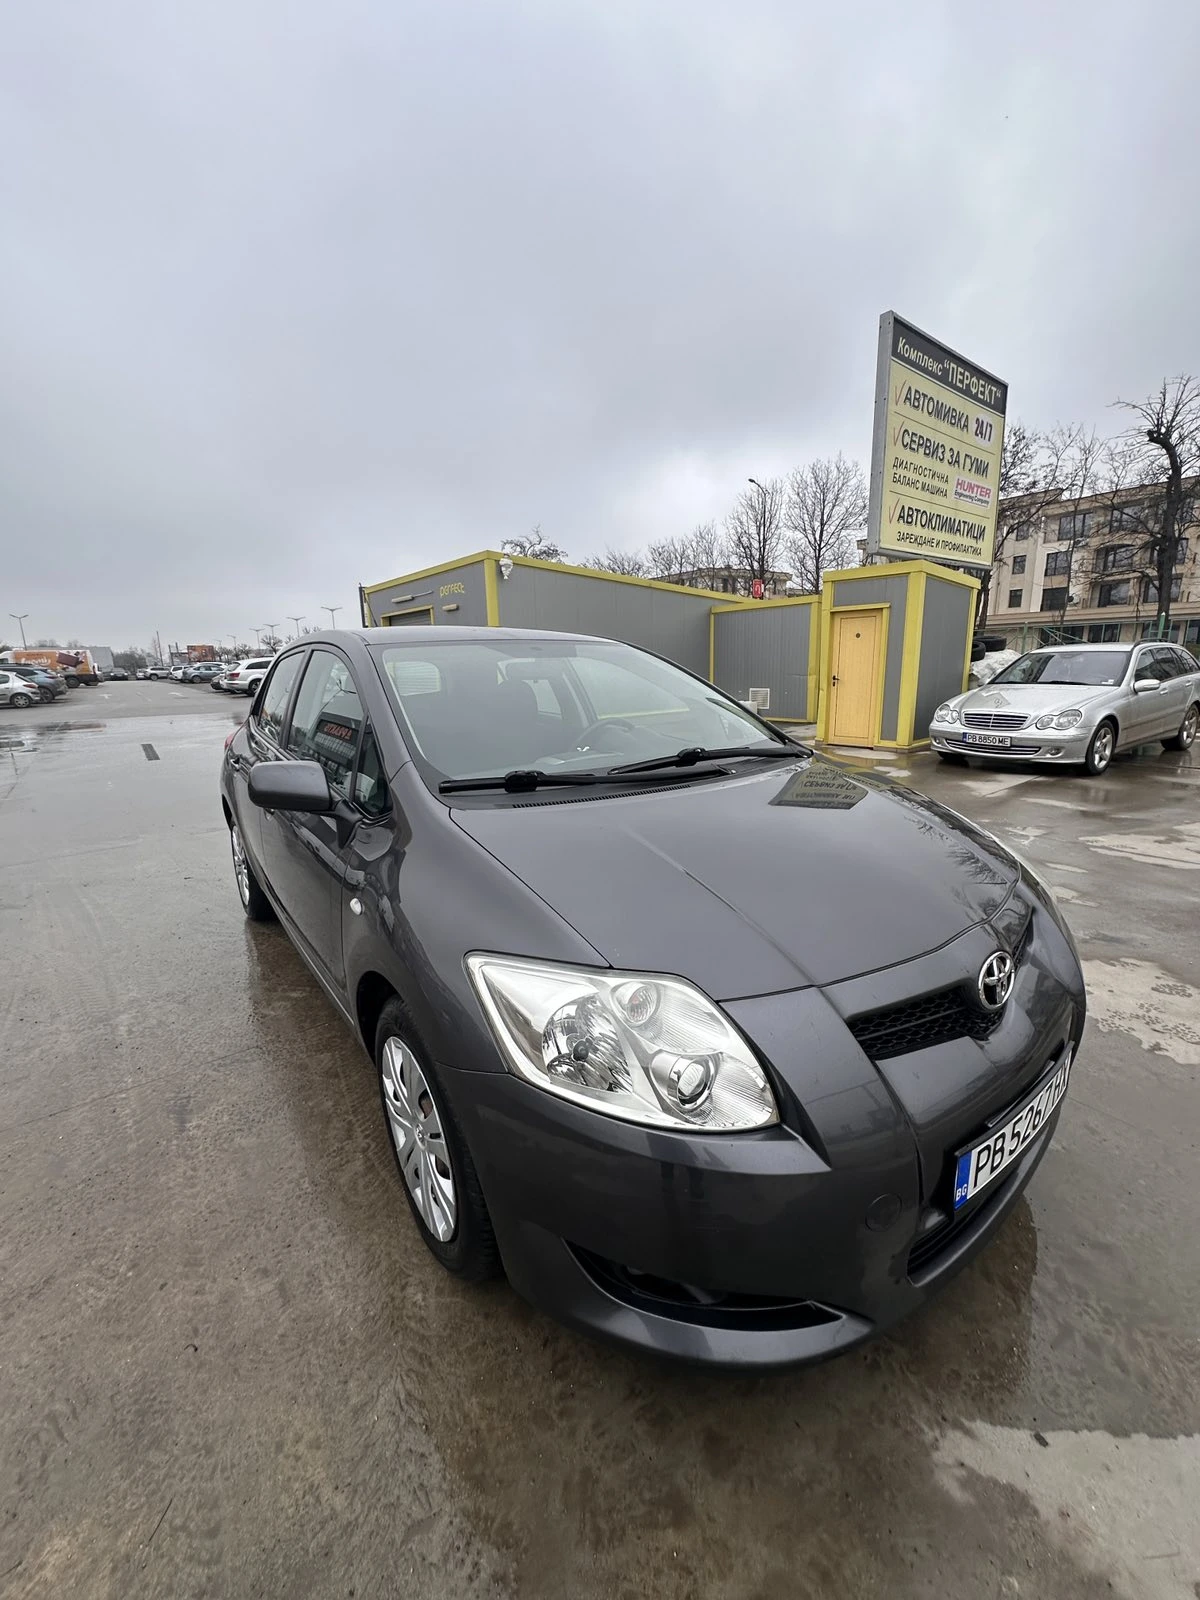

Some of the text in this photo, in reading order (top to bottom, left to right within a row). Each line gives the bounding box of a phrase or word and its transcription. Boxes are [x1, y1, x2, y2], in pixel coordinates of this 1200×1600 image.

[898, 337, 943, 376] Комплекс
[903, 386, 993, 442] АВТОМИВКА 24/7
[892, 457, 949, 484] ДИАГНОСТИЧНА
[901, 429, 990, 479] СЕРВИЗ ЗА ГУМИ
[892, 472, 948, 499] БАЛАНС МАШИНА
[955, 478, 992, 499] HUNTER
[897, 504, 986, 544] АВТОКЛИМАТИЦИ
[896, 531, 982, 557] ЗАРЕЖДАНЕ И ПРОФИЛАКТИКА
[973, 1131, 1007, 1188] PB
[1008, 1079, 1056, 1156] 5267
[955, 1184, 968, 1201] BG
